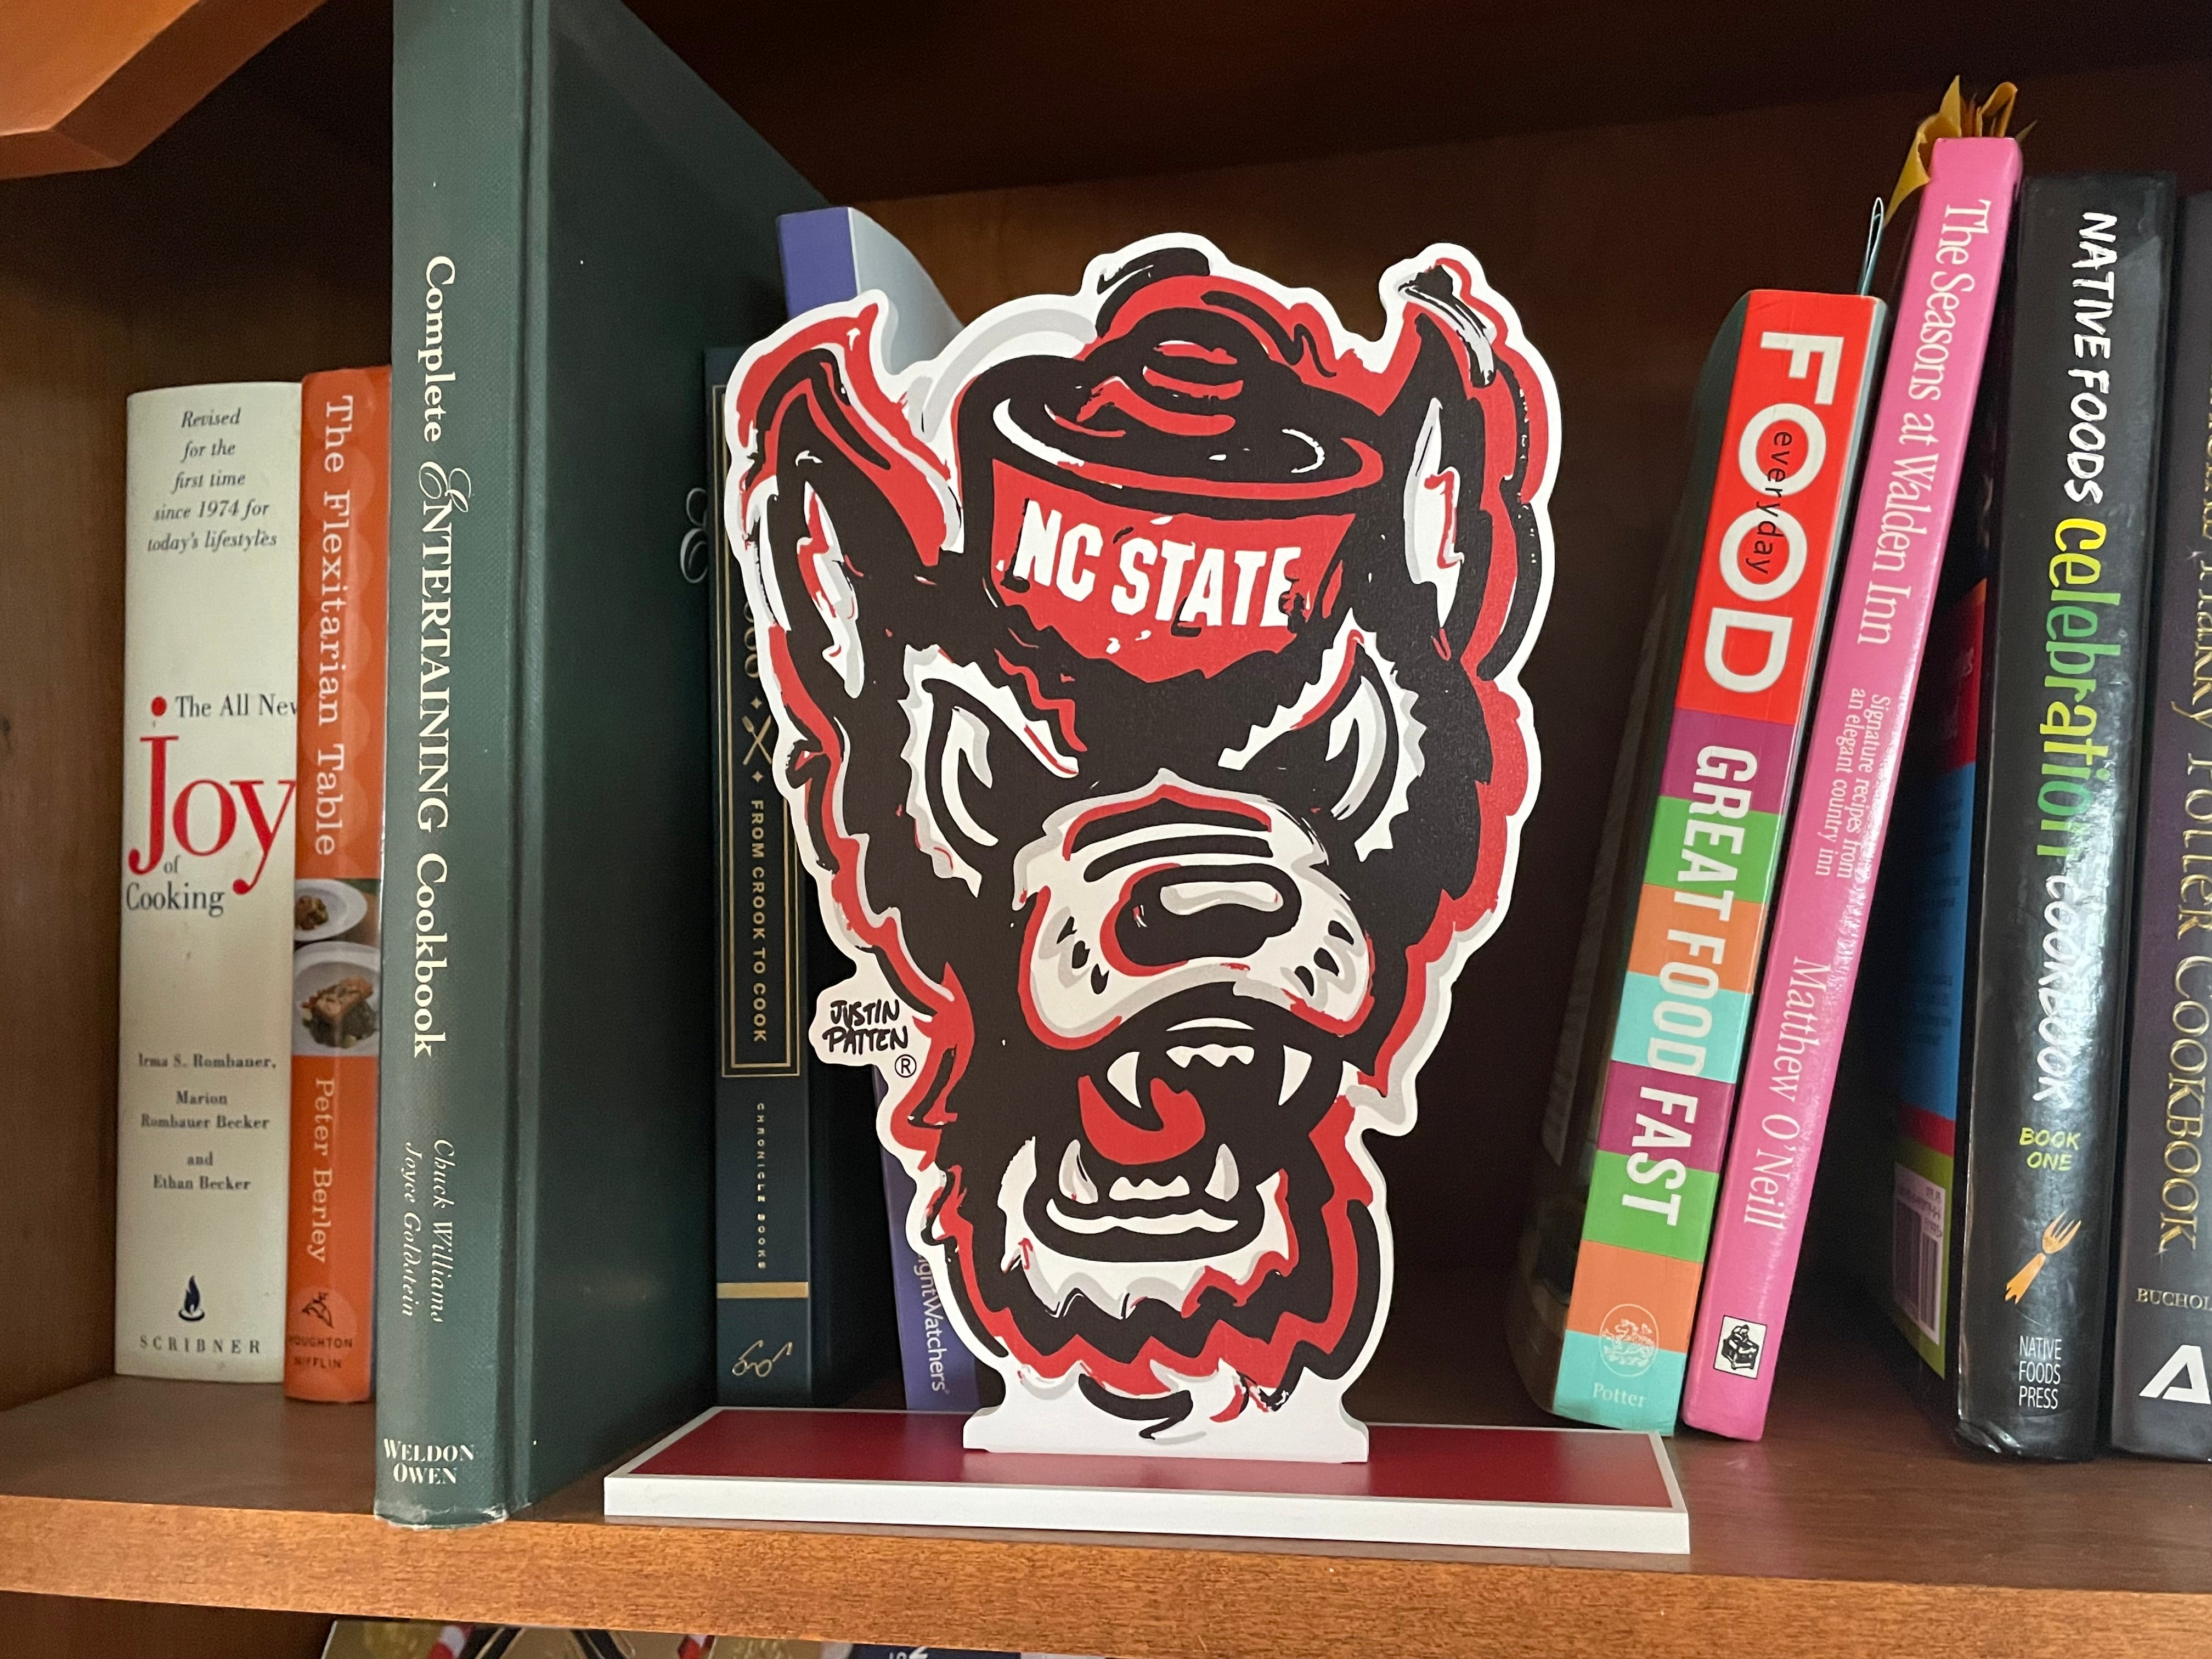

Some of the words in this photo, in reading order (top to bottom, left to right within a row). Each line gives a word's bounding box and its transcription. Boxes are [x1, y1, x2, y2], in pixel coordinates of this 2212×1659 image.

[1935, 199, 1991, 266] The
[2072, 211, 2118, 359] NATIVE
[418, 256, 455, 443] Complete
[1908, 270, 1975, 401] Seasons
[181, 408, 241, 428] Revised
[324, 395, 353, 472] The
[1898, 412, 1939, 447] at
[2064, 369, 2110, 504] FOODS
[180, 441, 206, 463] for
[211, 439, 235, 456] the
[154, 505, 190, 521] since
[199, 500, 239, 517] 1974
[241, 498, 269, 521] for
[172, 472, 202, 494] first
[210, 470, 245, 487] time
[1745, 431, 1793, 575] everyday
[1704, 331, 1844, 693] FOOD
[1874, 453, 1939, 572] Walden
[148, 531, 198, 554] today's
[205, 529, 277, 552] lifestyles
[1013, 499, 1103, 602] NC
[1111, 538, 1301, 627] STATE
[318, 490, 351, 725] Flexitarian
[1857, 580, 1911, 645] Inn
[175, 696, 211, 717] The
[220, 693, 248, 716] All
[1848, 688, 1865, 709] an
[1836, 715, 1865, 774] elegant
[1858, 694, 1891, 772] Signature
[315, 743, 345, 855] Table
[1817, 778, 1847, 842] country
[1847, 777, 1872, 834] recipes
[751, 799, 764, 859] FROM
[1673, 745, 1757, 922] GREAT
[164, 855, 180, 874] of
[1815, 848, 1837, 876] inn
[1837, 838, 1861, 879] from
[127, 881, 225, 918] Cooking
[752, 866, 766, 940] CROOK
[415, 853, 447, 1058] Cookbook
[753, 947, 766, 974] TO
[753, 982, 767, 1042] COOK
[831, 999, 900, 1028] JUSTIN
[1647, 929, 1726, 1076] FOOD
[1768, 955, 1831, 1103] Matthew
[139, 1053, 168, 1068] Irma
[174, 1054, 187, 1068] S.
[822, 1025, 908, 1055] PATTEN
[141, 1114, 211, 1128] Rombauer
[216, 1114, 270, 1129] Becker
[176, 1090, 227, 1105] Marion
[313, 1078, 335, 1156] Peter
[187, 1151, 213, 1166] and
[757, 1103, 765, 1203] CHRONICLE
[1622, 1086, 1698, 1226] FAST
[2019, 1127, 2081, 1150] BOOK
[2027, 1151, 2073, 1171] ONE
[153, 1174, 194, 1189] Ethan
[199, 1175, 251, 1190] Becker
[400, 1142, 422, 1203] Joyce
[433, 1139, 455, 1209] Chuck
[307, 1167, 332, 1262] Berley
[757, 1214, 766, 1269] BOOKS
[402, 1212, 421, 1316] Goldstein
[431, 1222, 453, 1323] Williams
[139, 1335, 260, 1354] SCRIBNER
[2019, 1335, 2062, 1360] NATIVE
[2019, 1361, 2061, 1385] FOODS
[1593, 1383, 1646, 1408] Potter
[2019, 1385, 2059, 1409] PRESS
[384, 1438, 475, 1462] WELDON
[393, 1462, 457, 1484] OWEN
